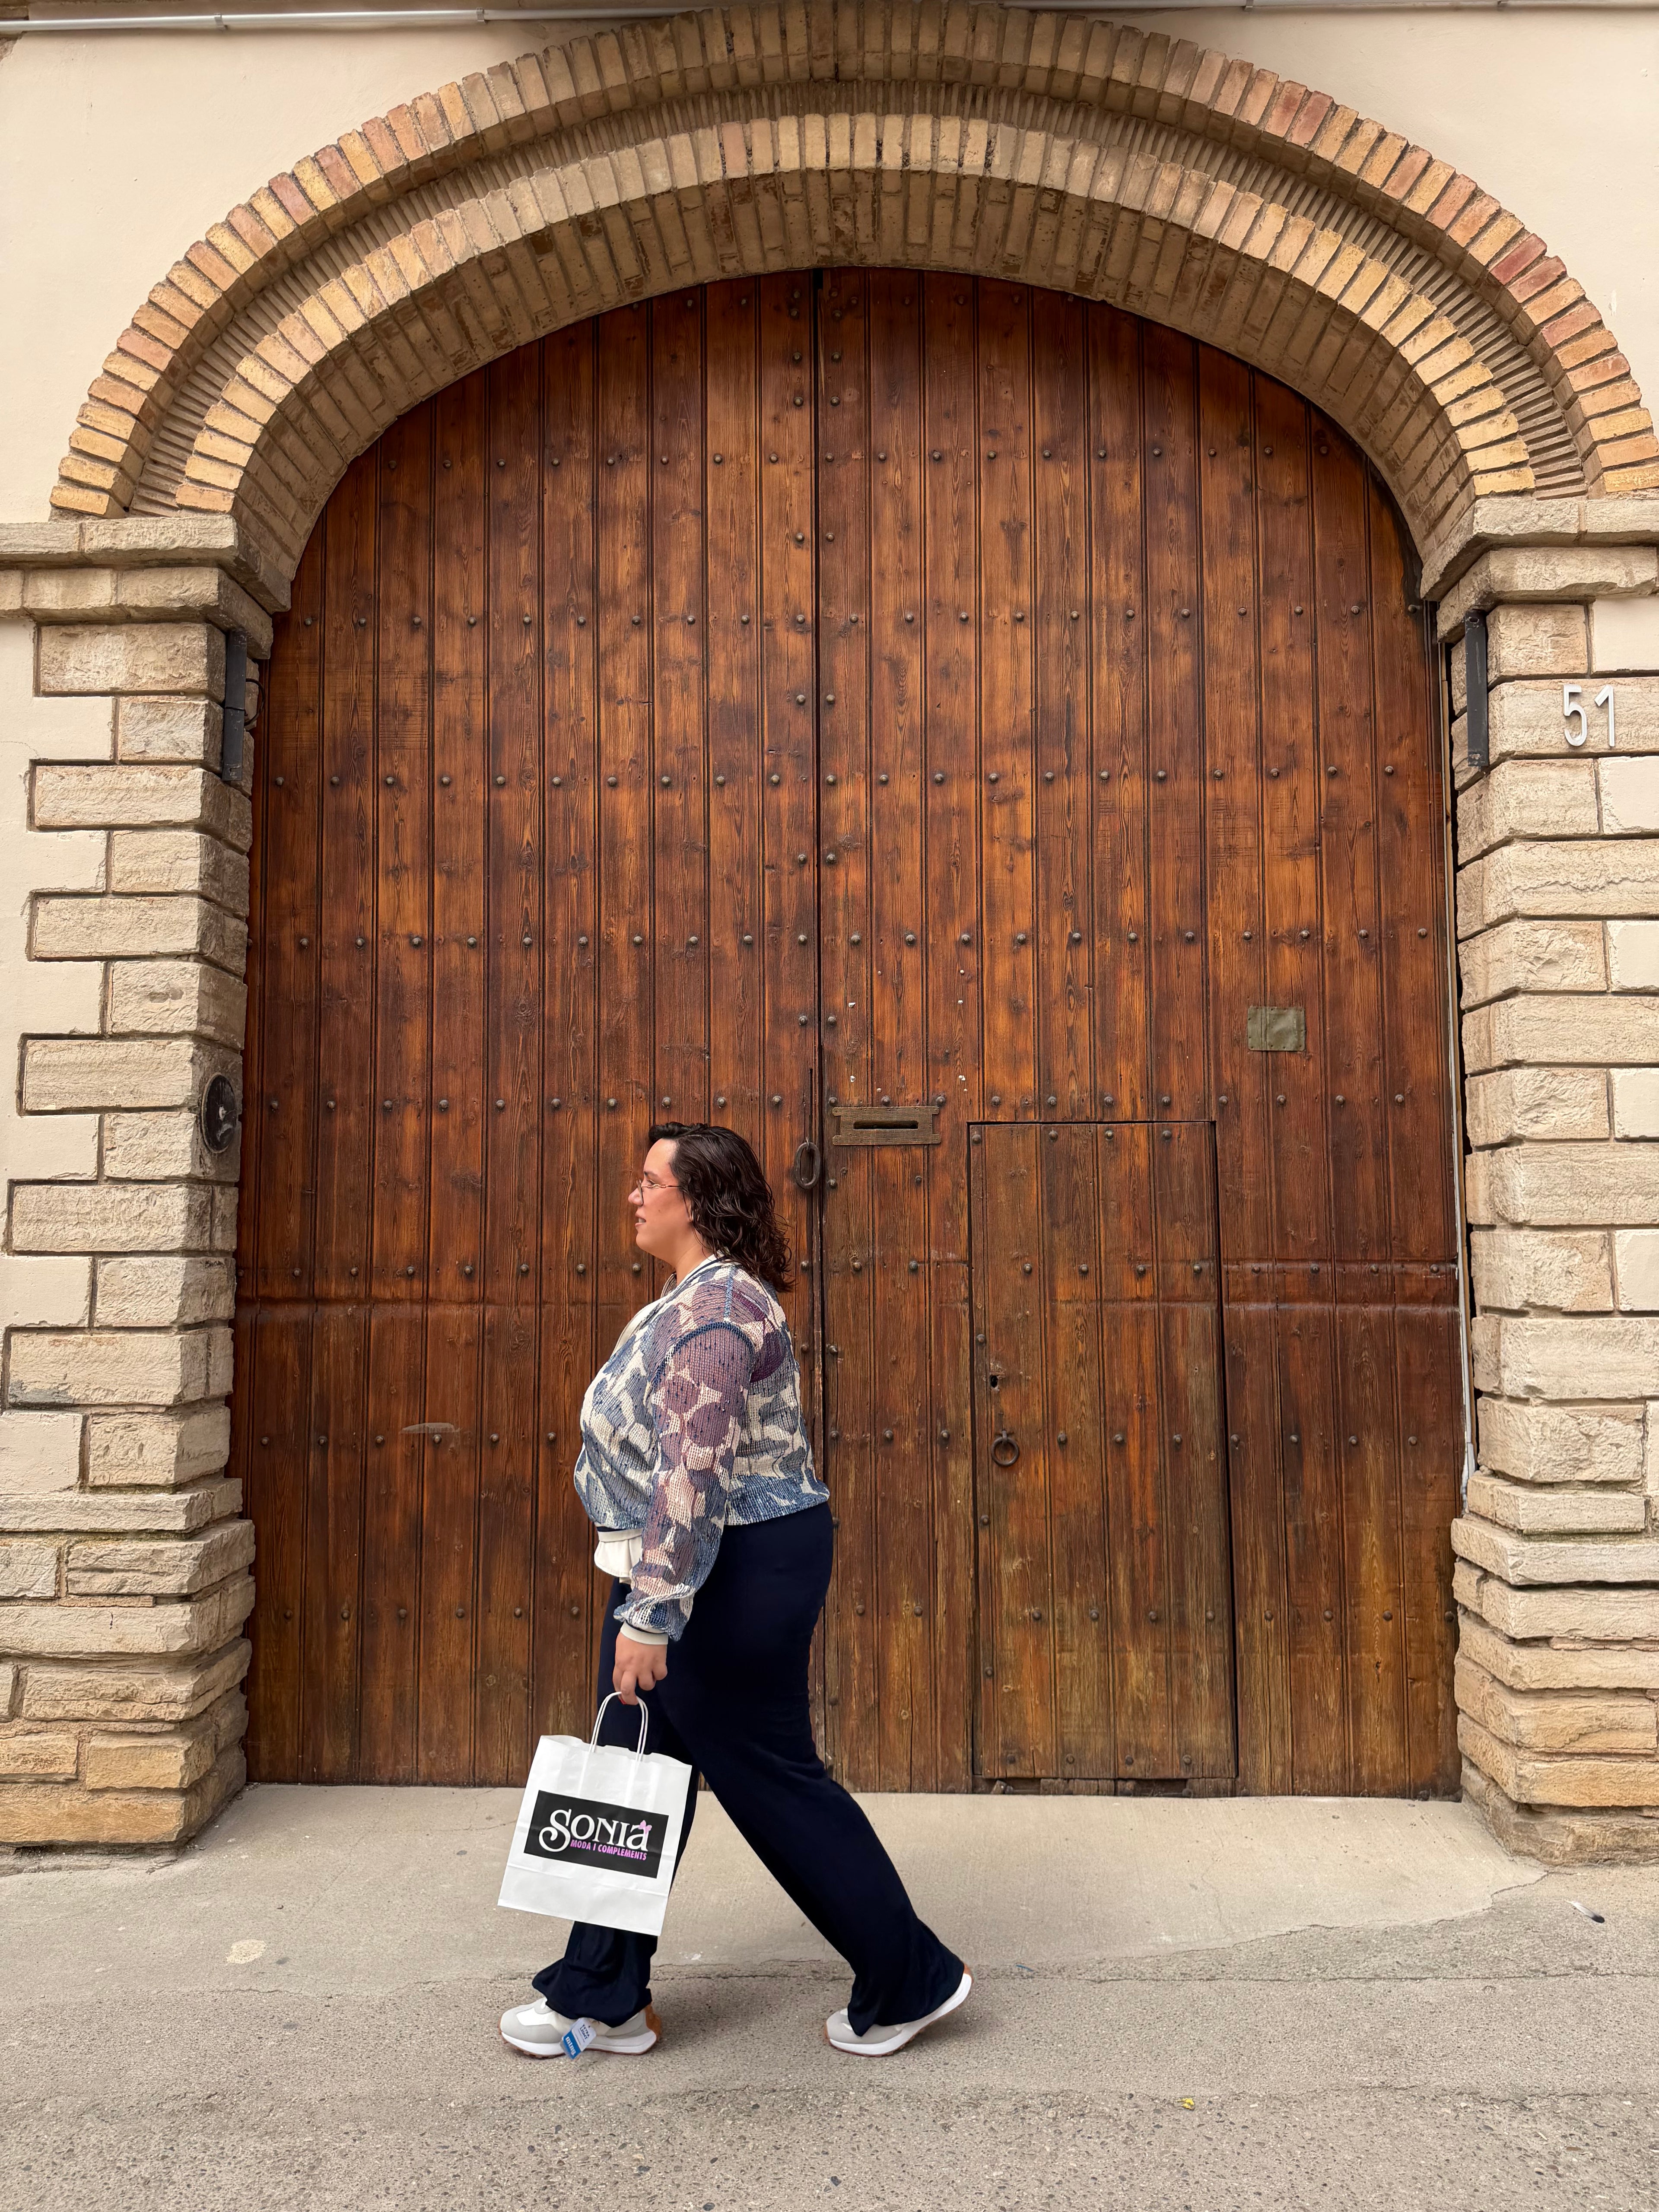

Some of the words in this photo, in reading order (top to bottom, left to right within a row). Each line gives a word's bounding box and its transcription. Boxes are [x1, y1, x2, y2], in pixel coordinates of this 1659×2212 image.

[1564, 684, 1615, 747] 51
[570, 1840, 591, 1850] MODA
[598, 1844, 647, 1860] COMPLEMENTS
